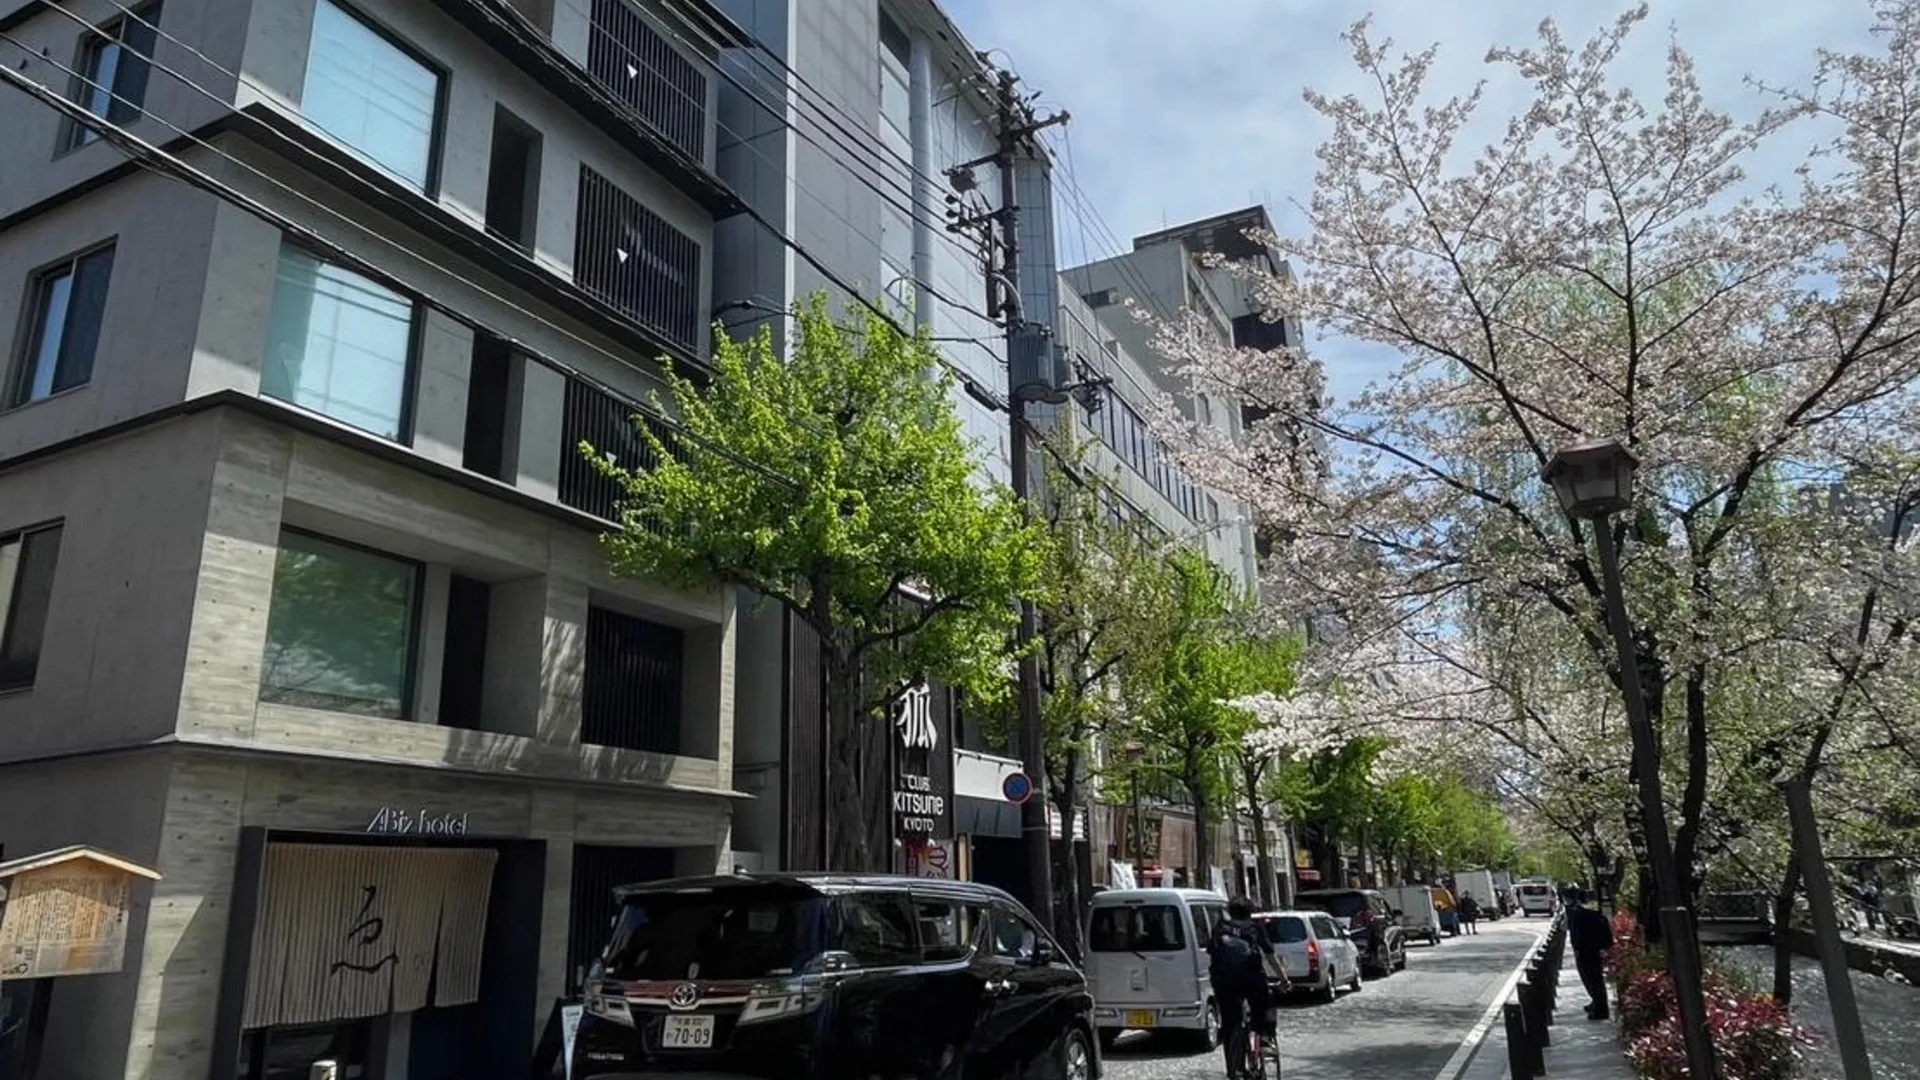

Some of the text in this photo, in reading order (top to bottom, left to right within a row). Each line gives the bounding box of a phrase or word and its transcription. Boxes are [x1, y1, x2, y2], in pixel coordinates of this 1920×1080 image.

[419, 809, 468, 835] hotel
[904, 817, 934, 832] KYOTO
[673, 1028, 710, 1045] 70-09
